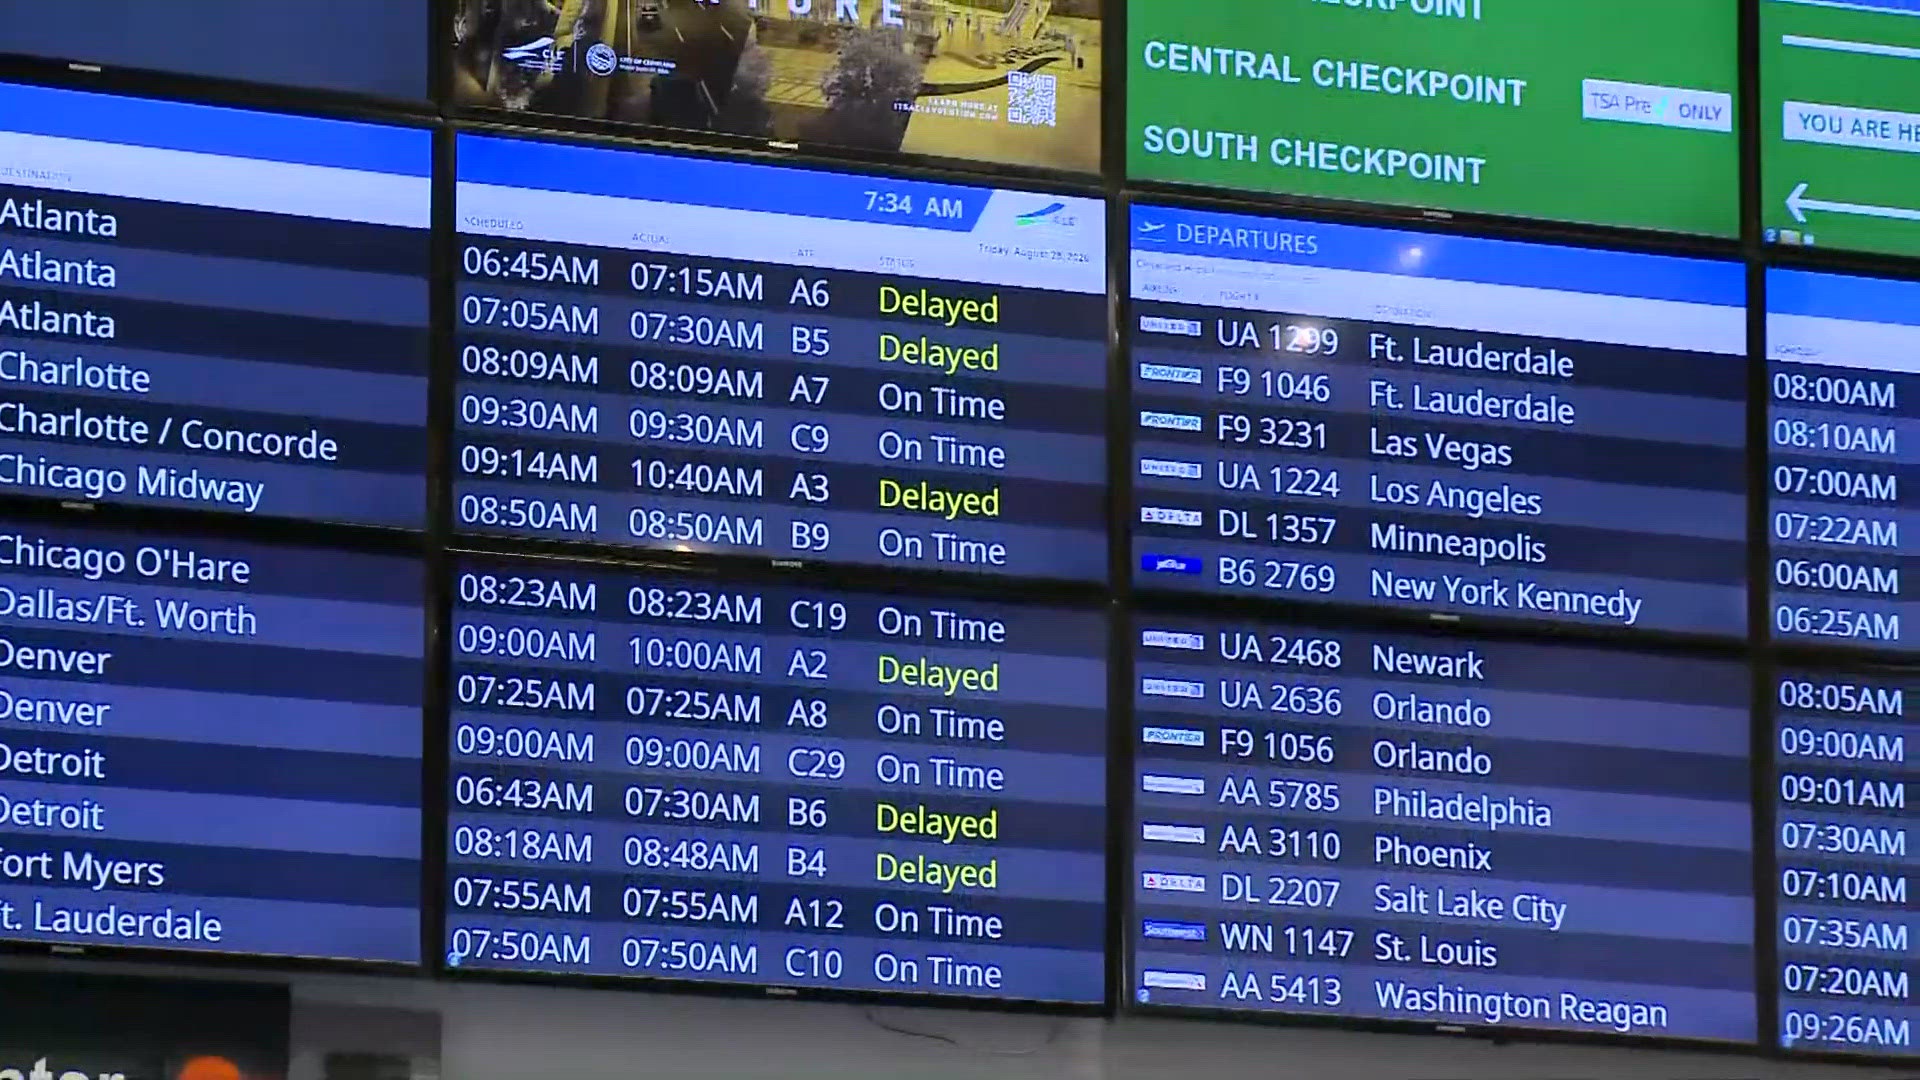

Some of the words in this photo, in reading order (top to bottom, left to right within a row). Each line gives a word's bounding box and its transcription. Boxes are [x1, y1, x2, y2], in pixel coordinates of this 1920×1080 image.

[1145, 41, 1301, 83] CENTRAL
[1313, 59, 1527, 106] CHECKPOINT
[1590, 92, 1620, 110] TSA
[1624, 96, 1652, 115] Pre
[1678, 102, 1722, 121] ONLY
[1798, 111, 1843, 134] YOU
[1851, 119, 1891, 139] ARE
[1144, 125, 1258, 162] SOUTH
[1271, 138, 1486, 184] CHECKPOINT
[0, 198, 117, 236] Atlanta
[864, 190, 912, 215] 7:34
[924, 197, 963, 219] AM
[631, 231, 670, 245] ACTUA
[1176, 223, 1319, 255] DEPARTURES
[0, 249, 115, 287] Atlanta
[464, 246, 598, 286] 06:45AM
[631, 262, 763, 301] 07:15AM
[789, 278, 830, 307] A6
[879, 286, 998, 327] Delayed
[463, 296, 598, 334] 07:05AM
[630, 311, 763, 350] 07:30AM
[792, 326, 830, 356] B5
[1218, 319, 1260, 348] UA
[1269, 321, 1338, 355] 1299
[1370, 333, 1404, 362] Ft.
[1414, 337, 1574, 377] Lauderdale
[0, 351, 150, 393] Charlotte
[462, 345, 598, 384] 08:09AM
[630, 360, 763, 398] 08:09AM
[789, 375, 830, 404] A7
[879, 383, 922, 412] On
[930, 387, 1005, 420] Time
[1774, 373, 1894, 408] 08:00AM
[1218, 366, 1250, 394] F9
[1261, 371, 1330, 402] 1046
[1371, 381, 1404, 409] Ft.
[1414, 384, 1575, 424] Lauderdale
[0, 402, 149, 444] Charlotte
[158, 417, 172, 444] /
[182, 419, 338, 461] Concorde
[791, 424, 829, 453] C9
[1218, 414, 1251, 442] F9
[1259, 417, 1325, 449] 3231
[1371, 427, 1418, 457] Las
[1425, 433, 1512, 470] Vegas
[0, 454, 126, 499] Chicago
[138, 466, 264, 513] Midway
[461, 445, 597, 483] 09:14AM
[631, 459, 763, 496] 10:40AM
[789, 472, 829, 502] A3
[880, 480, 999, 520] Delayed
[1218, 461, 1261, 491] UA
[1270, 467, 1341, 498] 1224
[1371, 475, 1420, 505] Los
[1426, 481, 1542, 518] Angeles
[1775, 466, 1896, 501] 07:00AM
[629, 508, 762, 546] 08:50AM
[792, 521, 830, 551] B9
[1219, 509, 1257, 538] DL
[1266, 513, 1336, 544] 1357
[1371, 523, 1546, 566] Minneapolis
[1775, 513, 1897, 547] 07:22AM
[0, 535, 125, 580] Chicago
[136, 547, 250, 584] O'Hare
[460, 573, 596, 611] 08:23AM
[790, 600, 846, 630] C19
[878, 607, 921, 636] On
[930, 610, 1005, 643] Time
[1219, 557, 1256, 586] B6
[1264, 561, 1335, 592] 2769
[1372, 569, 1436, 600] New
[1442, 575, 1508, 607] York
[1518, 583, 1642, 625] Kennedy
[155, 599, 257, 634] Worth
[1776, 606, 1899, 640] 06:25AM
[629, 637, 761, 674] 10:00AM
[788, 650, 828, 679] A2
[878, 656, 998, 696] Delayed
[1270, 636, 1341, 668] 2468
[1373, 644, 1484, 679] Newark
[458, 675, 594, 711] 07:25AM
[787, 699, 827, 728] A8
[1271, 684, 1342, 716] 2636
[1373, 693, 1491, 727] Orlando
[1780, 681, 1902, 716] 08:05AM
[788, 748, 845, 779] C29
[1264, 732, 1334, 763] 1056
[456, 776, 593, 812] 06:43AM
[625, 787, 759, 823] 07:30AM
[789, 798, 827, 827] B6
[877, 803, 997, 844] Delayed
[1219, 777, 1261, 806] AA
[1269, 780, 1340, 811] 5785
[1375, 788, 1551, 831] Philadelphia
[1781, 775, 1904, 809] 09:01AM
[624, 837, 758, 873] 08:48AM
[788, 848, 827, 877] B4
[1269, 828, 1340, 860] 3110
[1375, 836, 1492, 871] Phoenix
[1782, 822, 1905, 856] 07:30AM
[0, 847, 54, 880] ort
[63, 851, 164, 891] Myers
[0, 902, 22, 930] t.
[35, 902, 222, 942] Lauderdale
[454, 877, 591, 913] 07:55AM
[784, 898, 844, 929] A12
[875, 903, 919, 933] On
[927, 906, 1003, 939] Time
[1222, 874, 1261, 903] DL
[1268, 877, 1340, 908] 2207
[1375, 884, 1429, 914] Salt
[1438, 888, 1504, 920] Lake
[1512, 894, 1567, 931] City
[1220, 923, 1273, 952] WN
[1284, 927, 1354, 957] 1147
[1375, 933, 1411, 961] St.
[1421, 935, 1497, 967] Louis
[1784, 917, 1907, 951] 07:35AM
[786, 948, 842, 978] C10
[1785, 964, 1908, 998] 07:20AM
[1270, 975, 1342, 1006] 5413
[1375, 981, 1550, 1024] Washington
[1560, 993, 1667, 1032] Reagan
